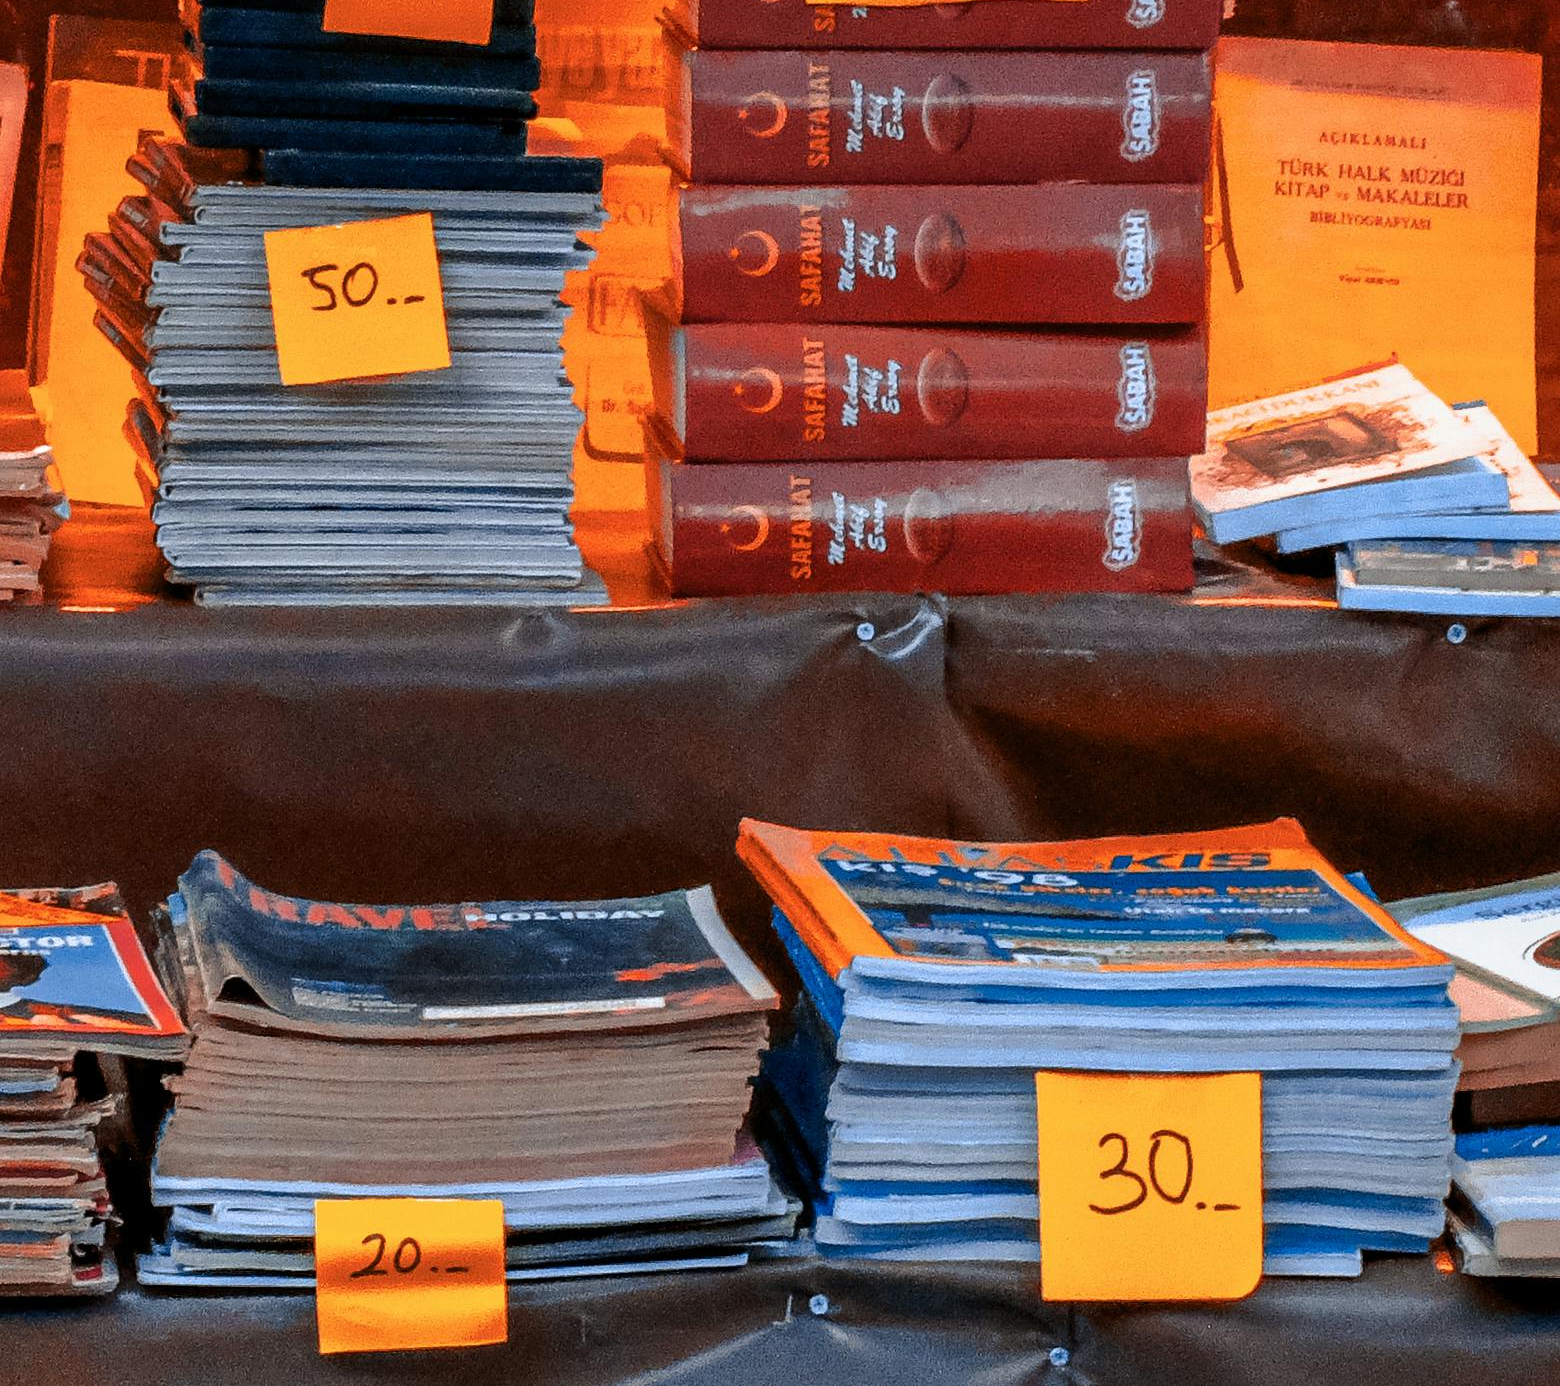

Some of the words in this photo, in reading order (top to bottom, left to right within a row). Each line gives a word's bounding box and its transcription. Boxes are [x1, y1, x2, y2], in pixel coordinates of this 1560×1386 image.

[808, 62, 831, 167] SAFAHAT
[1129, 73, 1153, 153] SABAH
[1278, 158, 1329, 178] TÜRK
[1338, 163, 1392, 183] HALK
[1357, 185, 1469, 209] MAKALELER
[800, 204, 822, 307] SAFAHAT
[1124, 211, 1148, 294] SABAH
[803, 337, 825, 443] SAFAHAT
[1124, 345, 1149, 425] SABAH
[790, 475, 812, 580] SAFAHAT
[1112, 482, 1137, 565] SABAH
